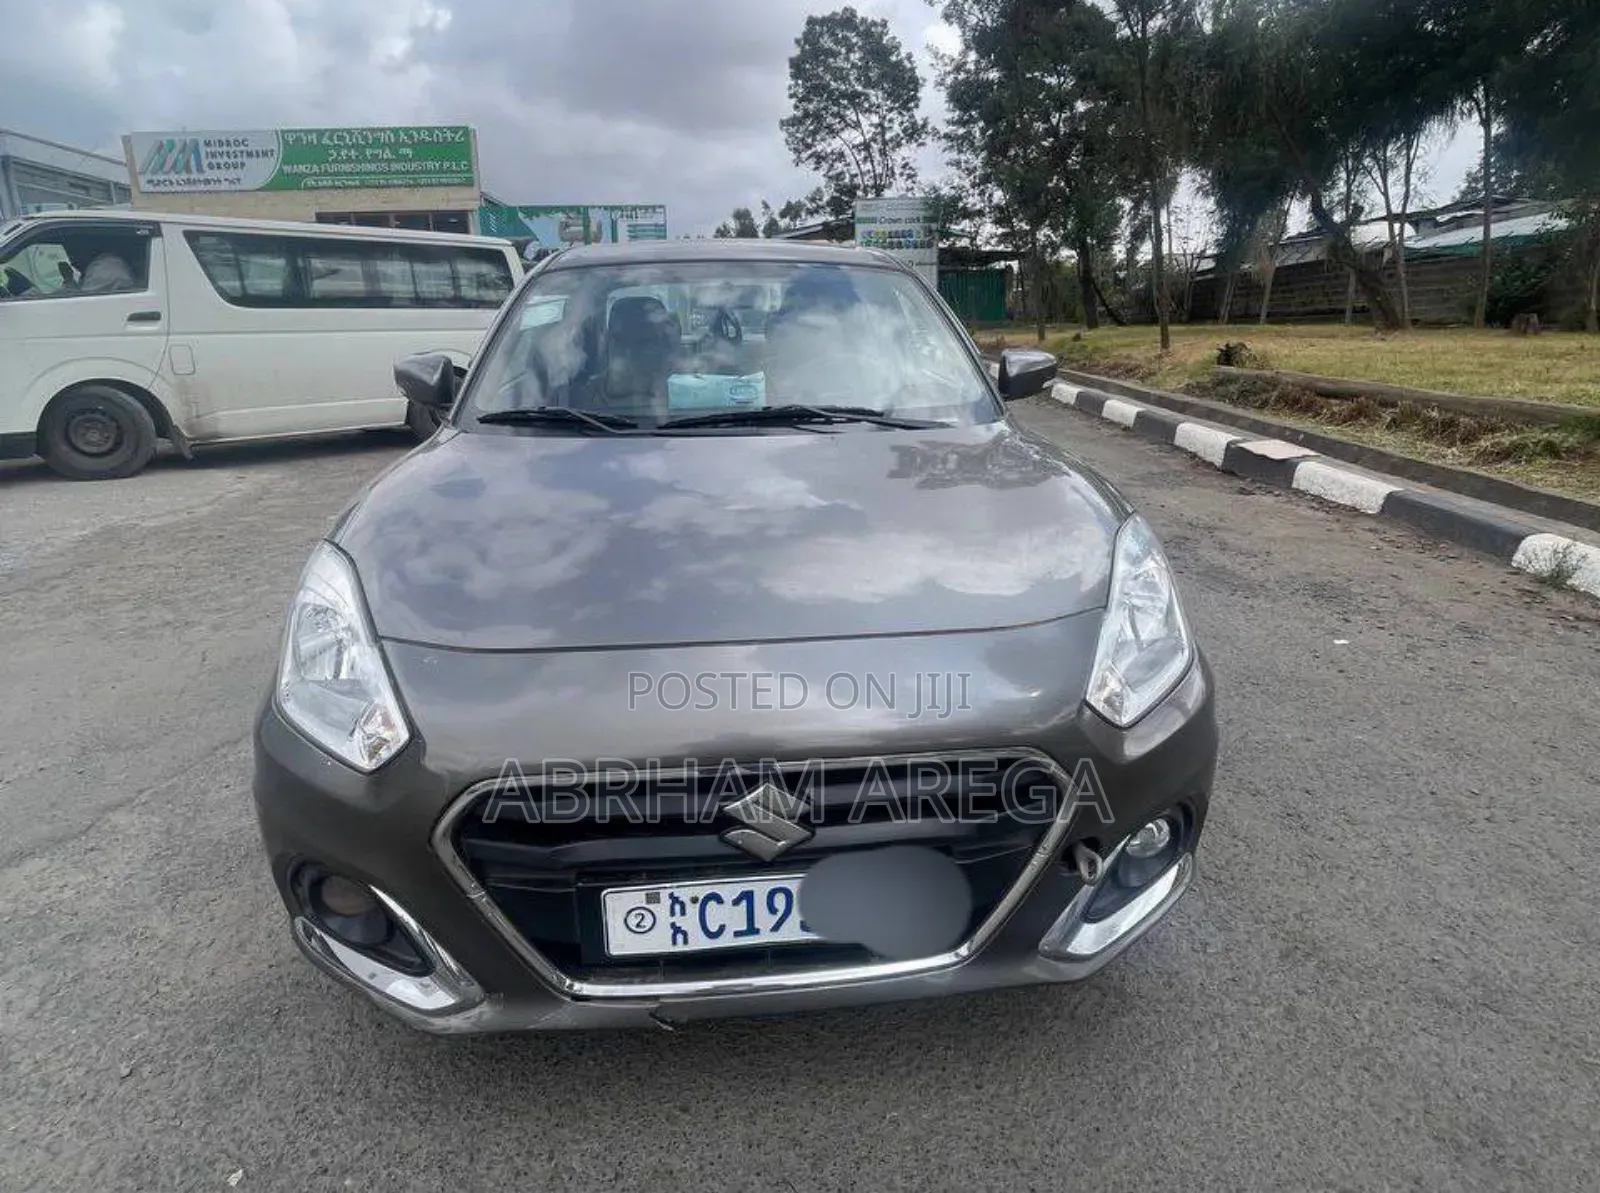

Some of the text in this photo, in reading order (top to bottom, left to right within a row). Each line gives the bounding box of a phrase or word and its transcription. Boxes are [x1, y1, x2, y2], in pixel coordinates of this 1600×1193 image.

[203, 138, 249, 148] MIDROC
[205, 148, 276, 159] INVESTMENT
[206, 160, 246, 170] GROUP
[699, 886, 814, 940] C19
